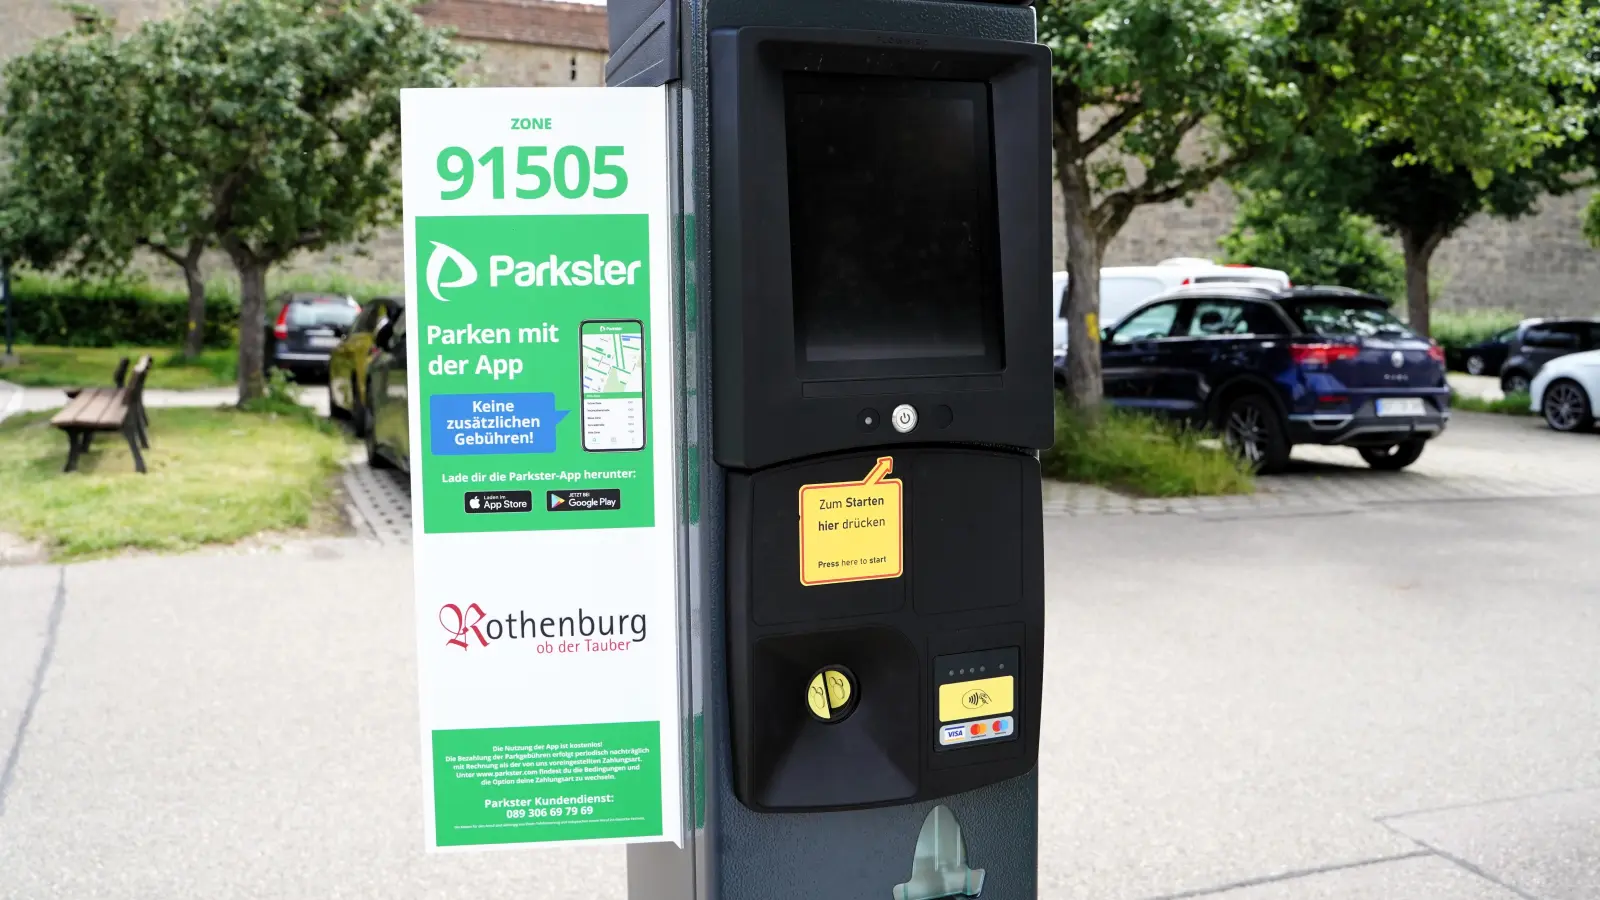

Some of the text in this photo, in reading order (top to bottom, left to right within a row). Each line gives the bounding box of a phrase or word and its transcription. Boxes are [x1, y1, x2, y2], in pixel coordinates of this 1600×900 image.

[510, 118, 552, 130] ZONE
[436, 145, 629, 200] 91505
[489, 254, 642, 287] Parkster
[427, 322, 559, 345] Parken mit
[428, 355, 523, 380] der App
[472, 400, 514, 412] Keine
[447, 416, 540, 430] zusätzlichen
[454, 432, 533, 445] Gebühren!
[442, 470, 636, 483] Lade dir die Parkster-App herunter:
[484, 500, 527, 510] App Store
[569, 498, 616, 508] Google Play
[820, 496, 884, 510] Zum Starten
[818, 517, 885, 531] hier drücken
[818, 560, 839, 568] Press
[439, 602, 647, 651] Rothenburg
[537, 639, 631, 654] ob der Tauber
[505, 752, 551, 760] Parkgebühren
[485, 795, 614, 808] Parkster Kundendienst:
[506, 806, 593, 819] 089 306 69 79 69
